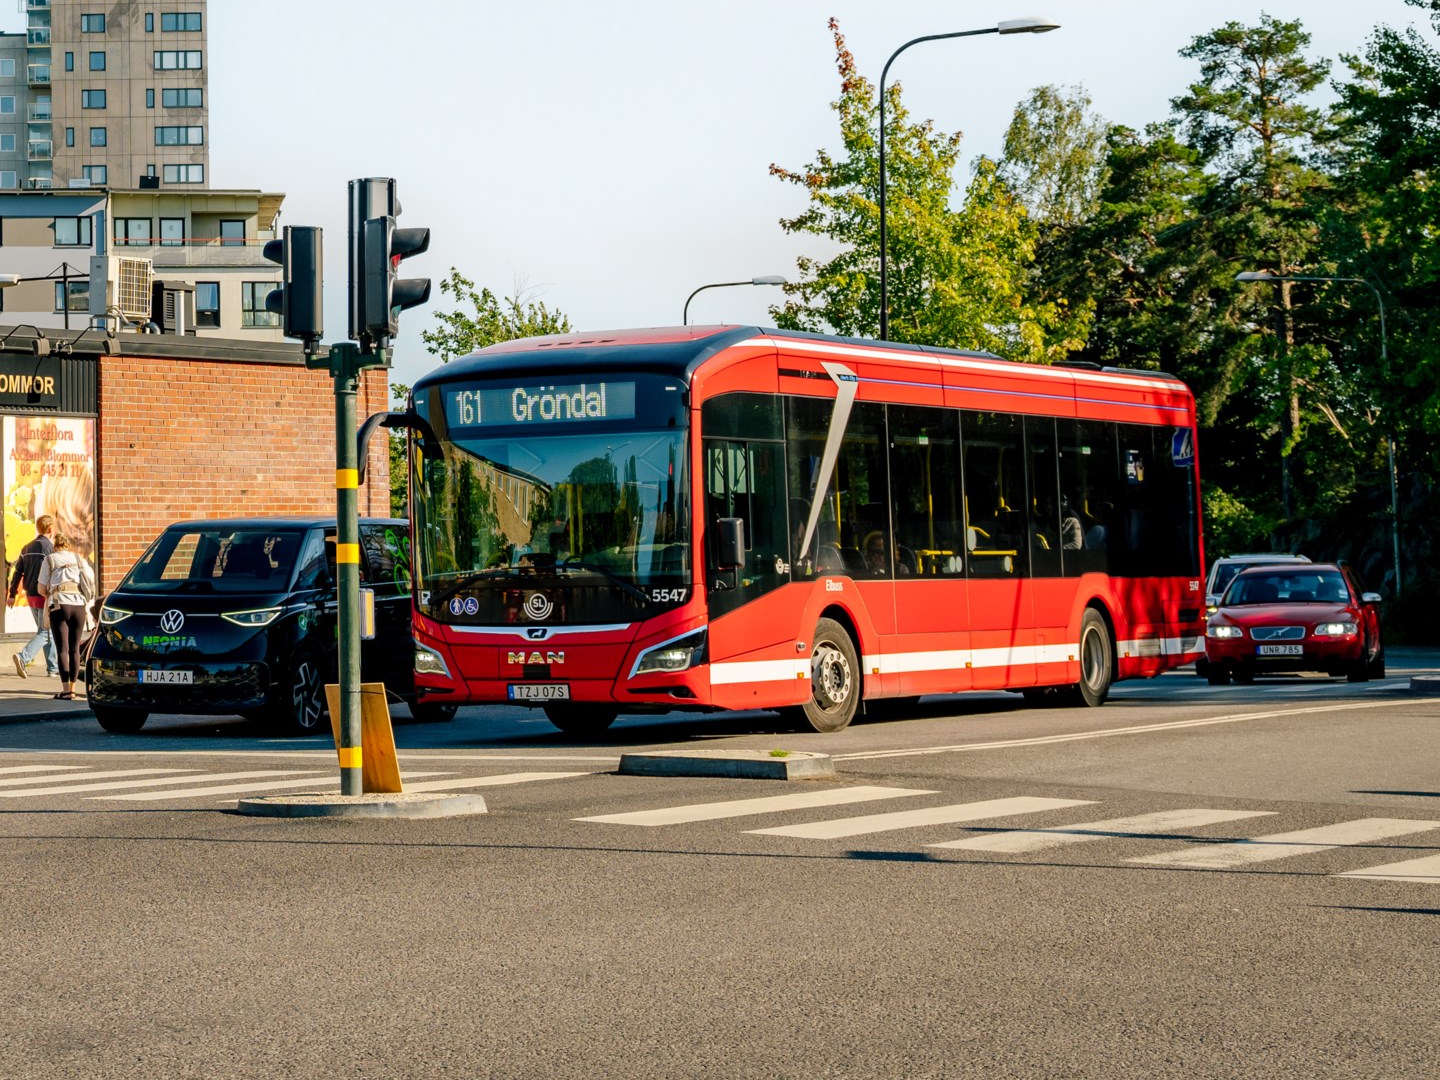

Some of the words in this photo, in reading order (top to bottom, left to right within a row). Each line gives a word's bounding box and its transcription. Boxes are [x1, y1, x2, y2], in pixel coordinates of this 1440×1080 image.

[455, 389, 482, 424] 161
[512, 382, 606, 421] Gröndal
[24, 424, 74, 441] Interflora
[20, 463, 31, 476] 08
[40, 463, 56, 477] 645
[652, 588, 687, 602] 5547
[531, 598, 544, 608] SL
[1262, 646, 1280, 654] UNR
[1282, 645, 1300, 654] 785
[507, 651, 565, 664] MAN
[146, 671, 166, 682] HJA
[168, 671, 189, 683] 21A
[517, 686, 539, 697] TZJ
[542, 685, 564, 697] 07S
